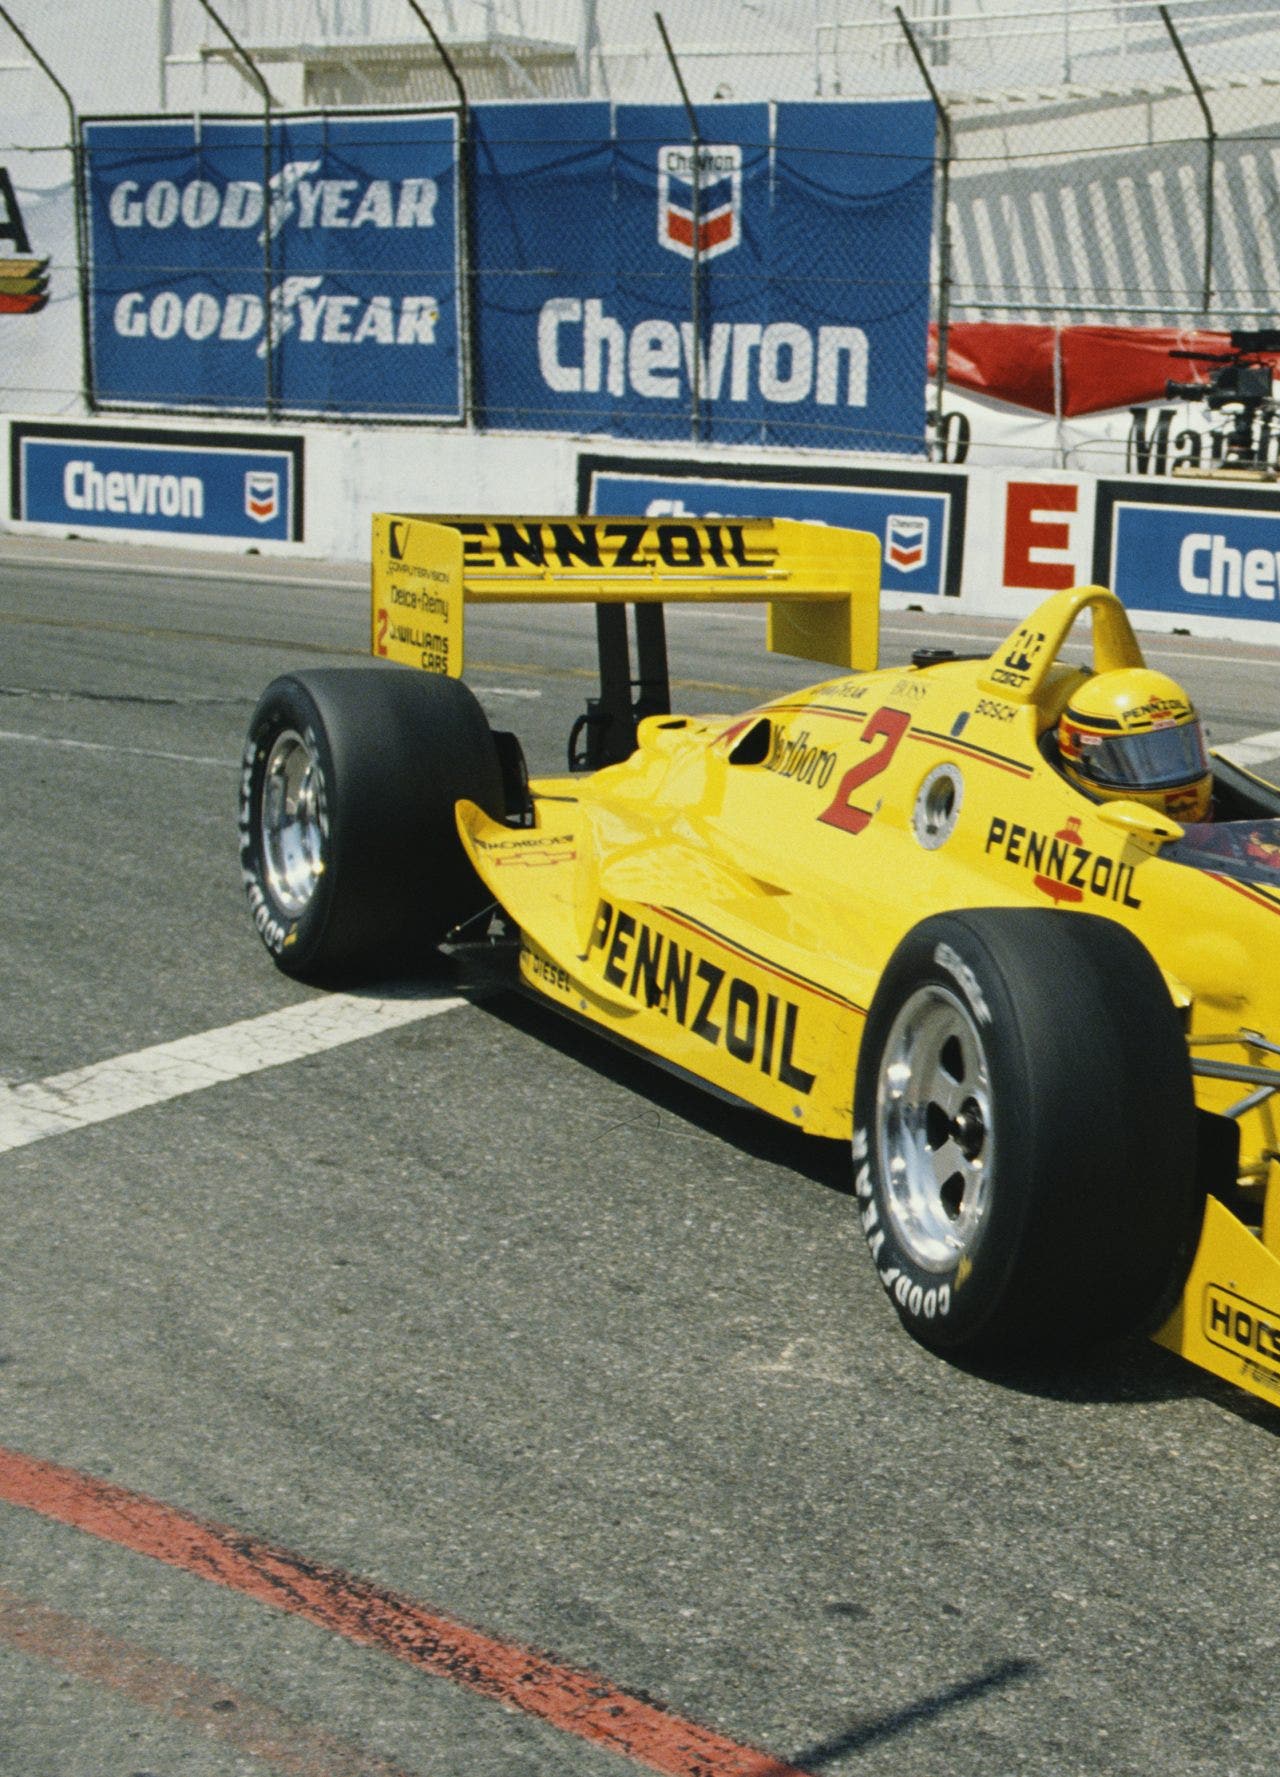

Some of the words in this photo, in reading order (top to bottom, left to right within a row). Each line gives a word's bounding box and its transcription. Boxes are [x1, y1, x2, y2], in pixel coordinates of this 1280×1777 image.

[537, 298, 869, 407] Chevron
[64, 460, 204, 519] Chevron
[450, 522, 776, 567] ENNZOIL
[1003, 482, 1079, 589] E
[378, 608, 388, 657] 2
[421, 652, 448, 674] CARS
[974, 698, 1018, 723] BOSCH
[1122, 699, 1192, 722] PENNZOIL
[761, 724, 837, 789] Marlboro
[817, 706, 911, 835] 2
[985, 816, 1142, 909] PENNZOIL
[577, 897, 817, 1095] PENNZOIL
